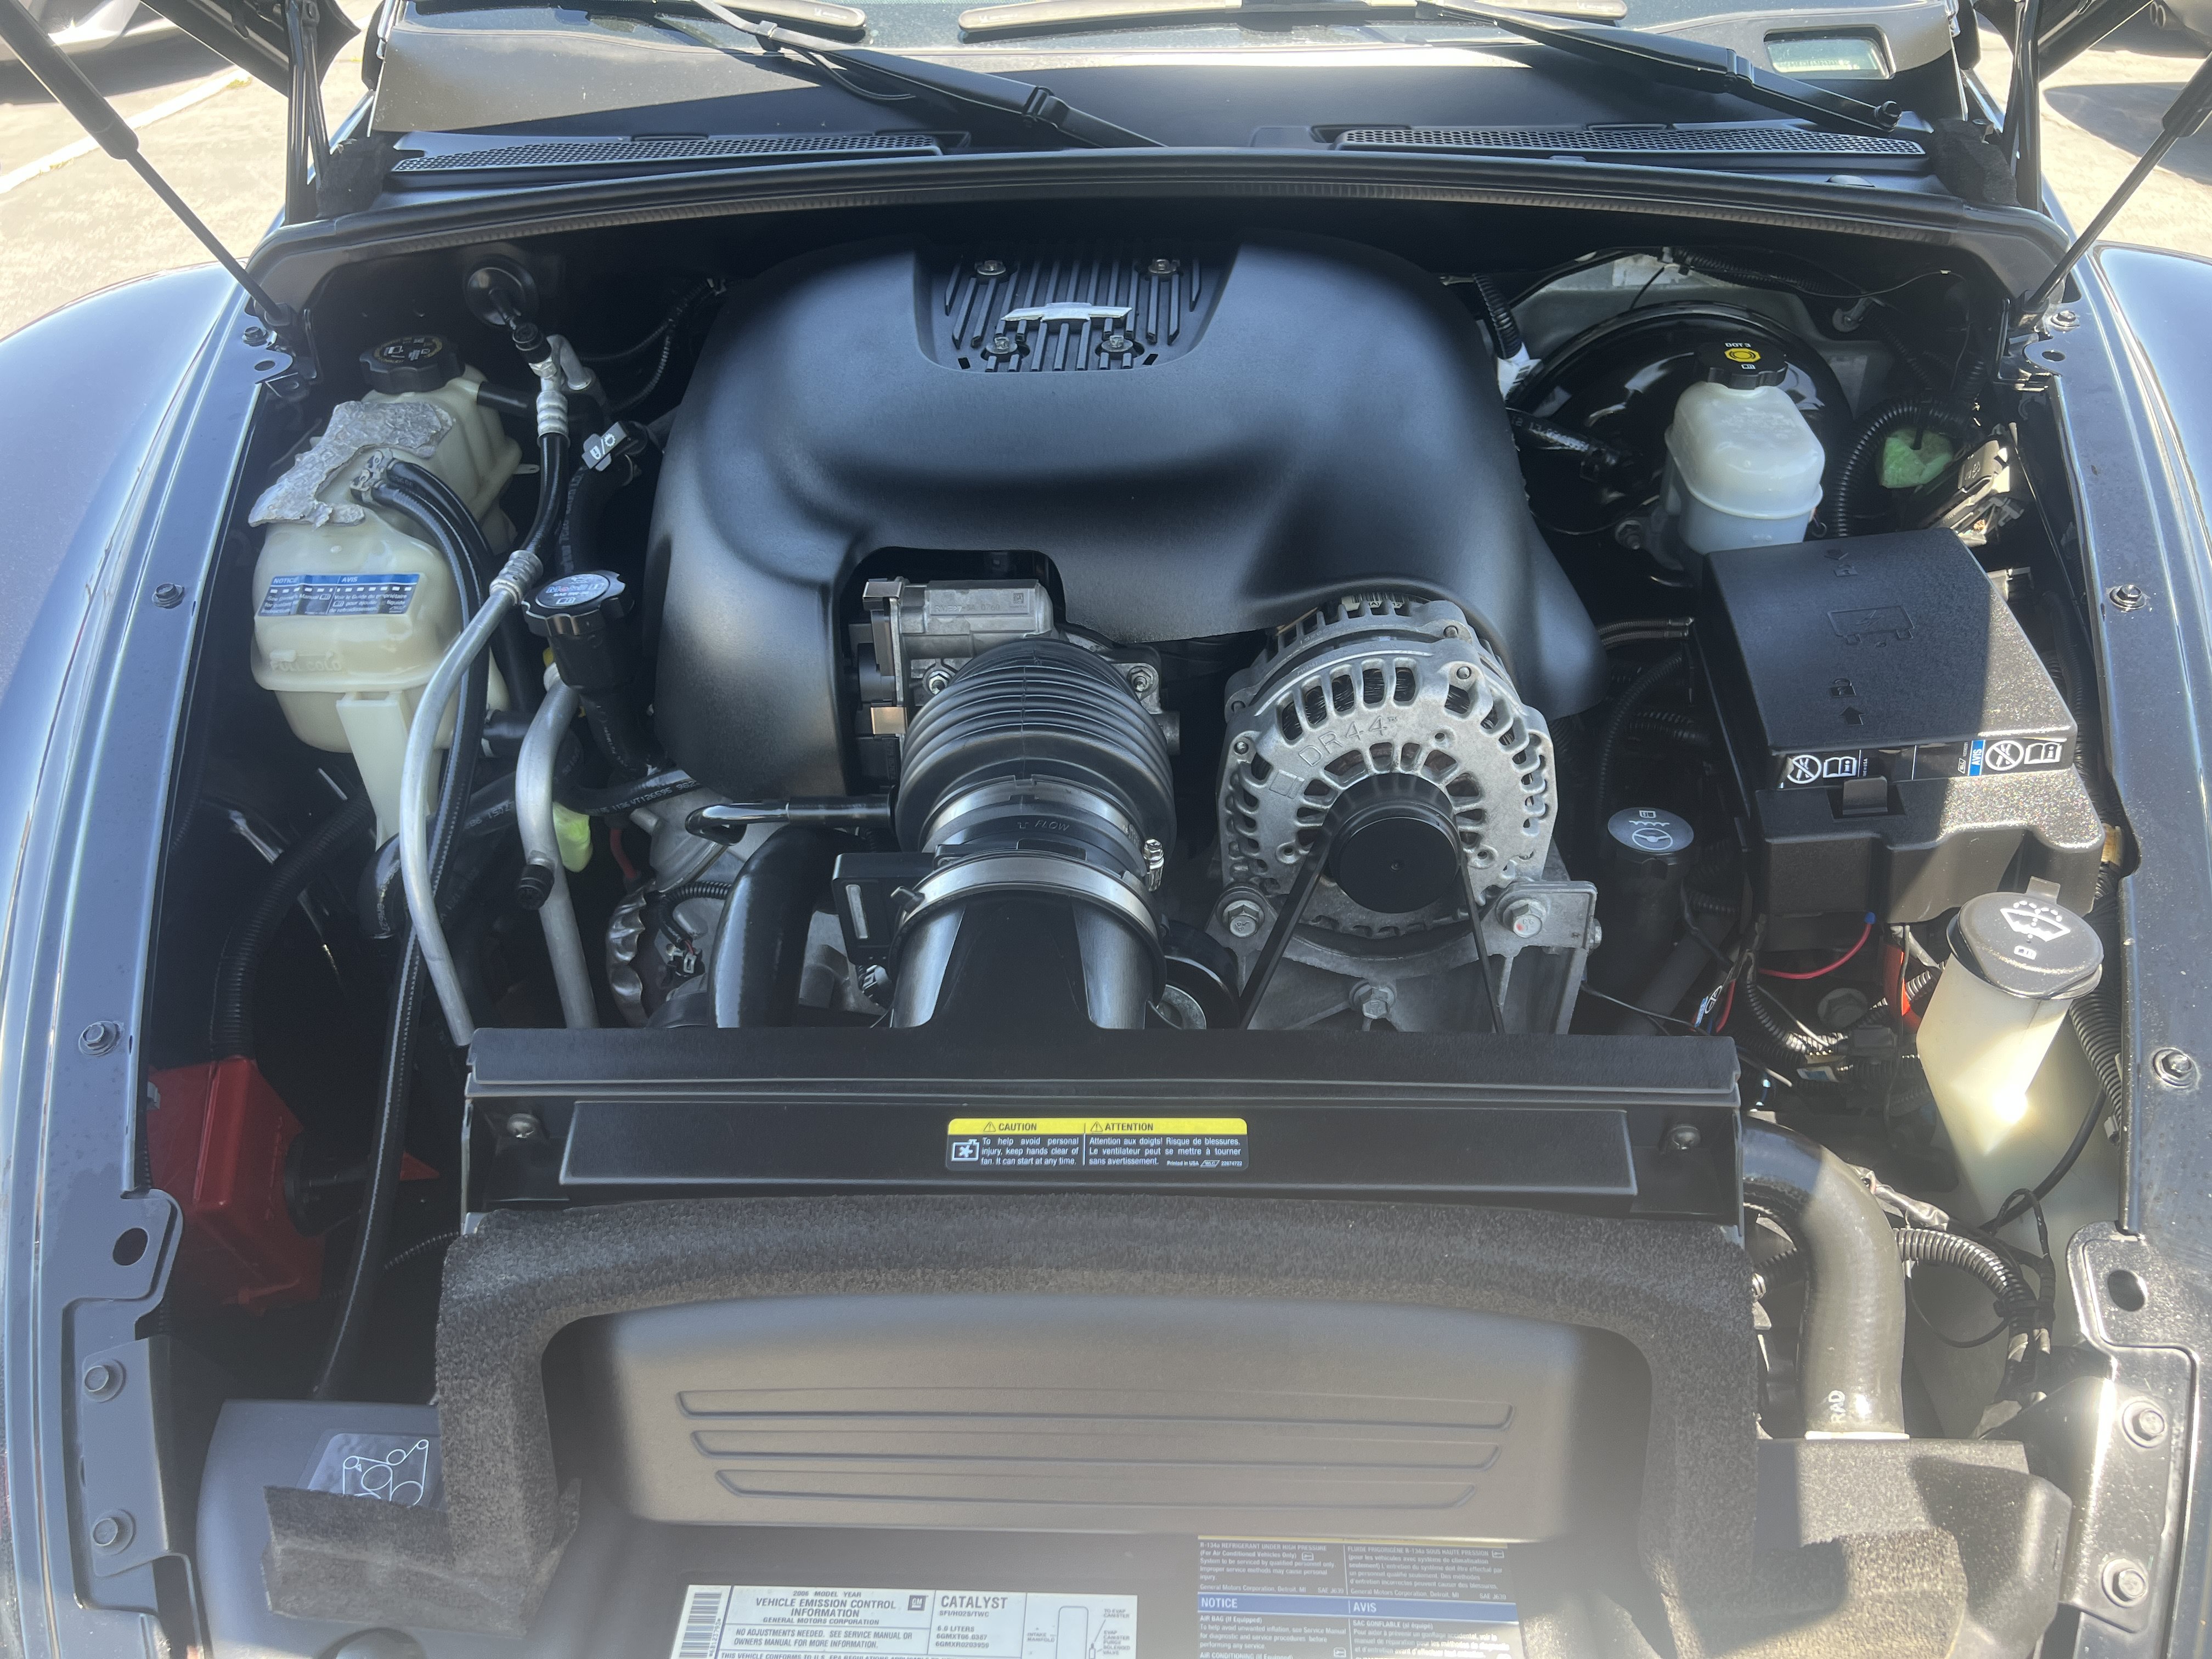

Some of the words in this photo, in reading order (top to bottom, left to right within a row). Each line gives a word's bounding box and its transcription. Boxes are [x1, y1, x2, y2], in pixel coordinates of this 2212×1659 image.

[1971, 748, 1982, 766] AVIS
[1034, 820, 1070, 831] FLOW
[997, 1122, 1038, 1131] CAUTION
[1105, 1122, 1153, 1131] ATTENTION
[997, 1136, 1013, 1146] help
[1047, 1136, 1079, 1146] personal
[1089, 1136, 1120, 1144] Attention
[1139, 1136, 1163, 1147] doigts!
[1165, 1137, 1189, 1147] Risque
[1005, 1147, 1023, 1156] keep
[1144, 1147, 1161, 1156] peut
[995, 1156, 1001, 1164] It
[1017, 1156, 1034, 1164] start
[1035, 1156, 1042, 1164] at
[1043, 1158, 1057, 1166] any
[1828, 1390, 1846, 1423] RAD
[755, 1598, 795, 1607] VEHICLE
[799, 1598, 847, 1608] EMISSION
[850, 1599, 898, 1610] CONTROL
[911, 1598, 923, 1606] GM
[940, 1596, 1009, 1611] CATALYST
[1201, 1596, 1237, 1609] NOTICE
[1353, 1600, 1376, 1613] AVIS
[791, 1609, 860, 1618] INFORMATION
[747, 1629, 795, 1638] ADJUSTMENTS
[797, 1630, 825, 1638] NEEDED.
[829, 1630, 841, 1639] SEE
[843, 1631, 871, 1639] SERVICE
[873, 1632, 900, 1640] MANUAL
[733, 1638, 762, 1646] OWNERS
[764, 1639, 791, 1647] MANUAL
[793, 1639, 807, 1647] FOR
[809, 1640, 828, 1648] MORE
[830, 1640, 878, 1649] INFORMATION.
